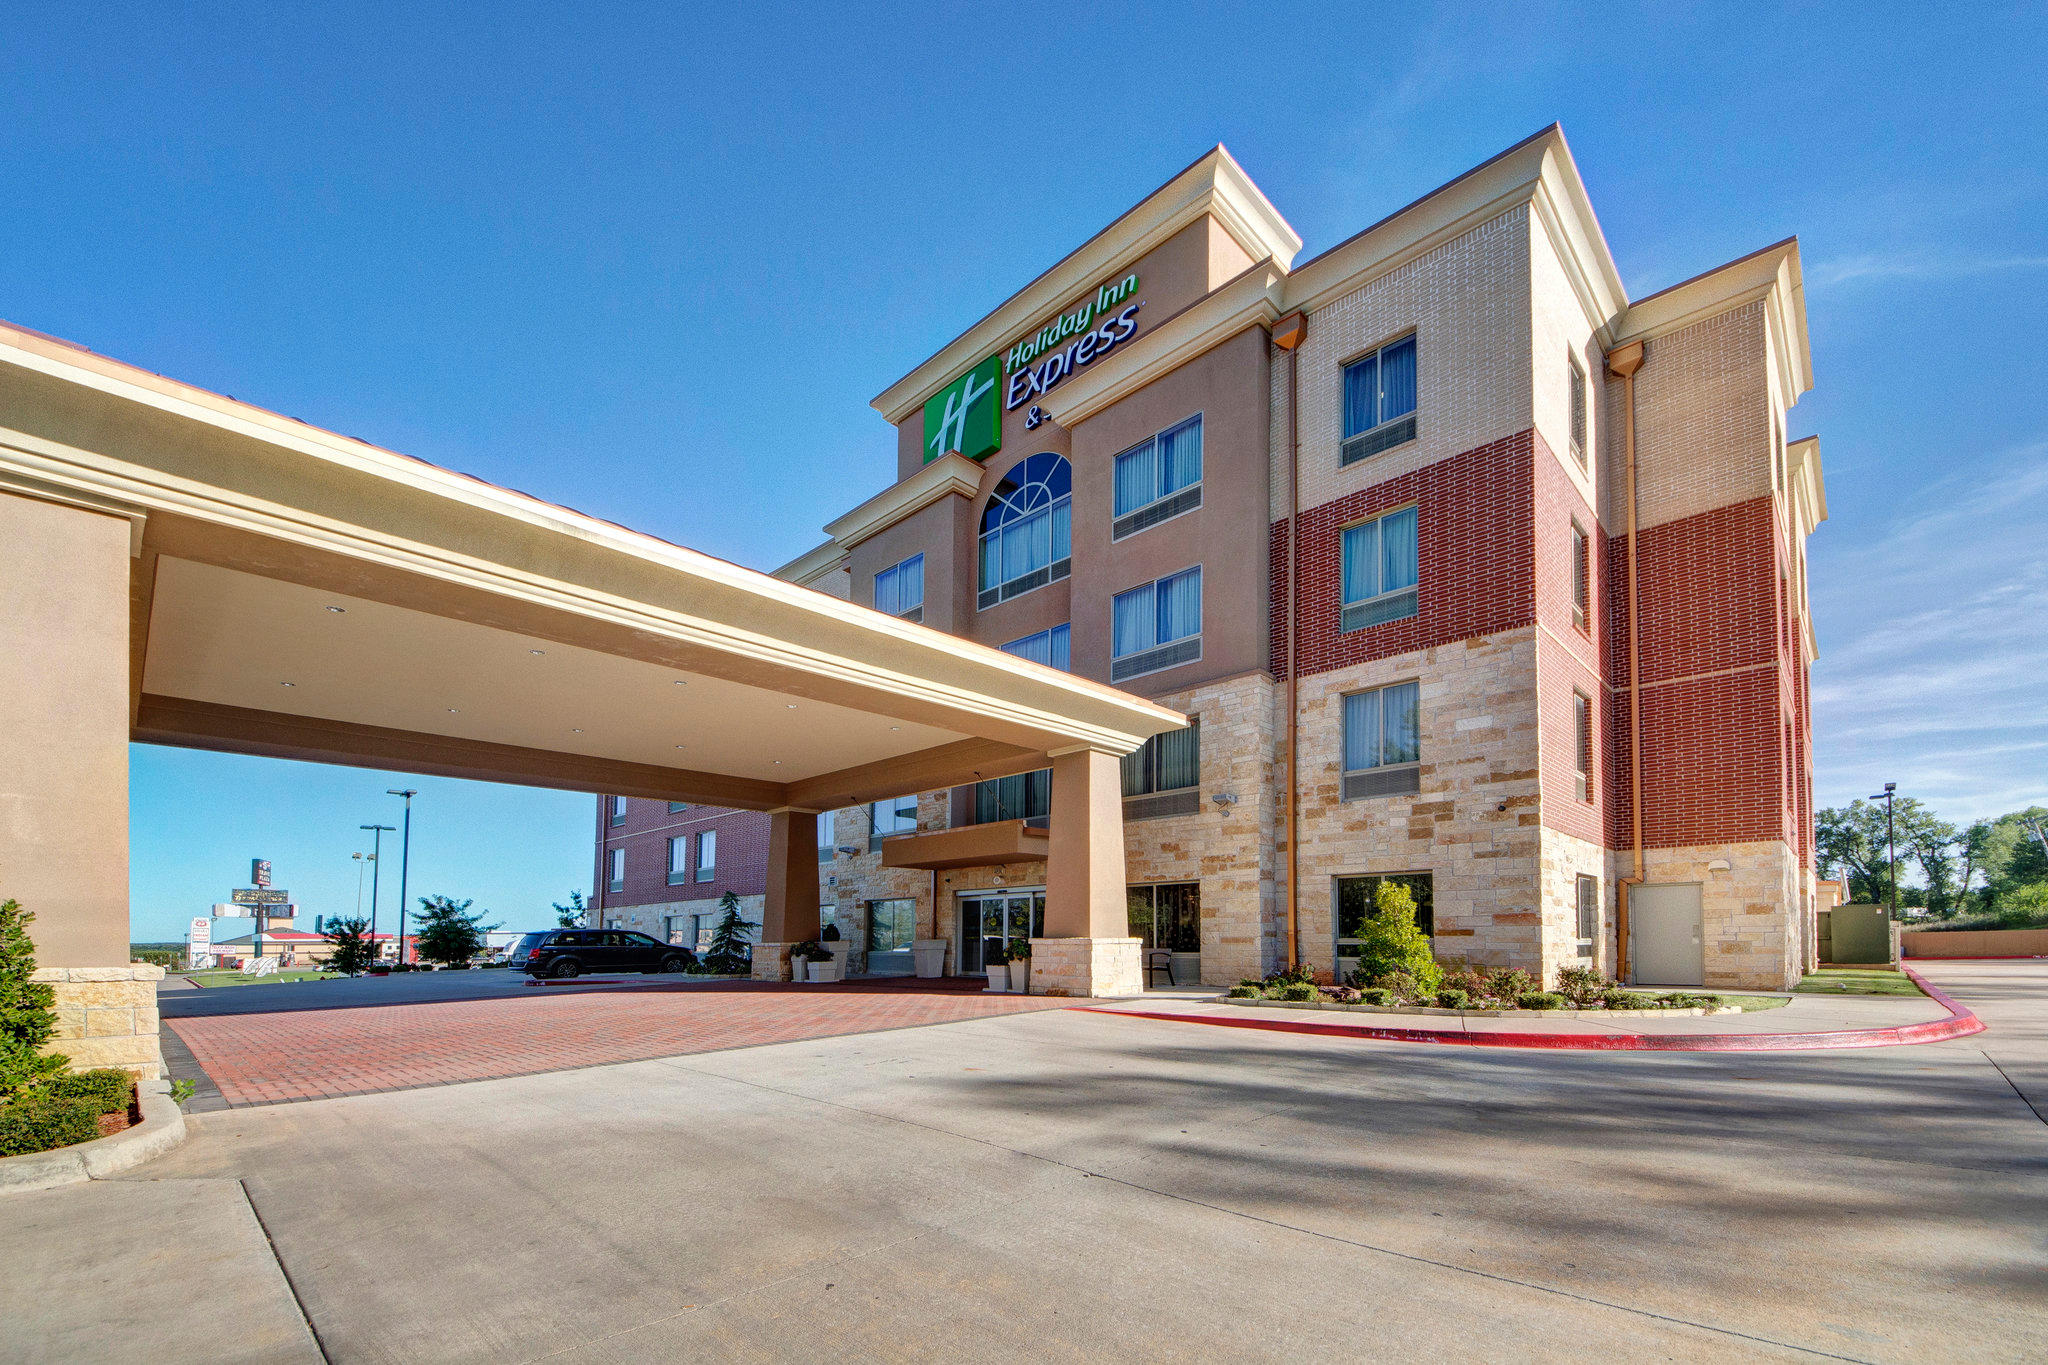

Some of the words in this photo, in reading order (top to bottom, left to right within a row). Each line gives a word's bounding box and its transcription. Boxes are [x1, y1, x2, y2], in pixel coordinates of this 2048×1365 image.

[1005, 301, 1095, 375] Holiday
[1096, 273, 1138, 314] Inn
[1006, 304, 1139, 411] Express
[1024, 404, 1042, 431] &
